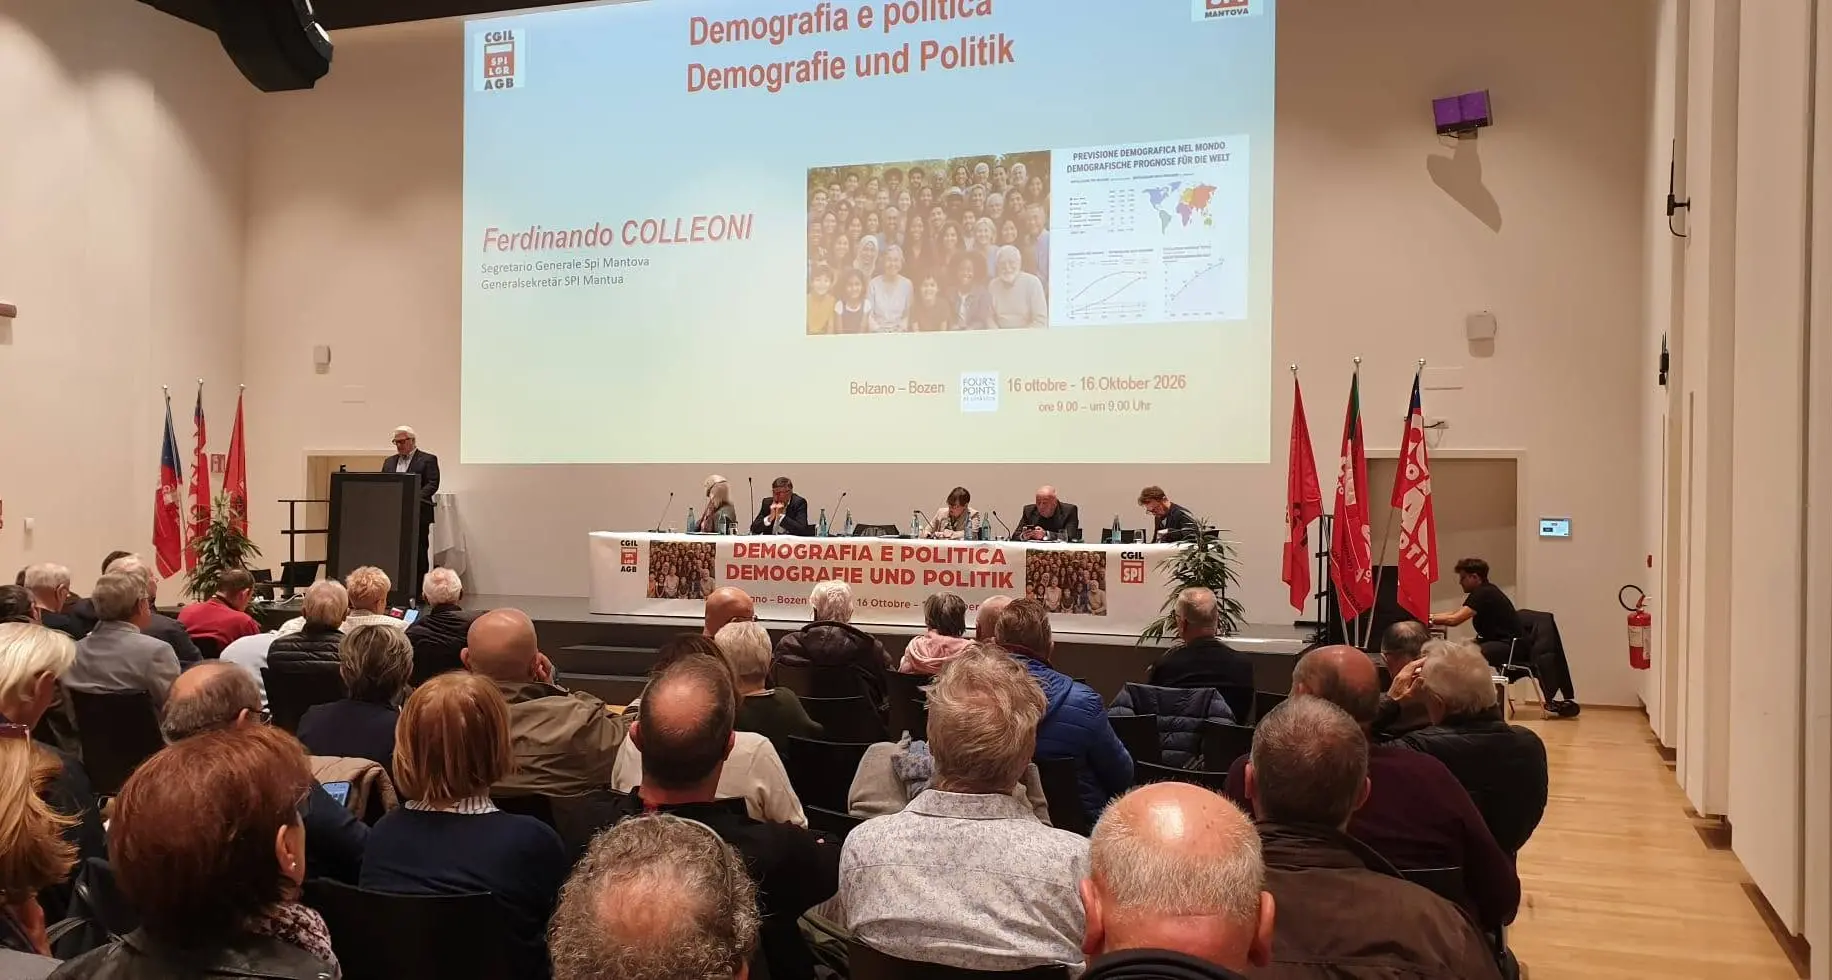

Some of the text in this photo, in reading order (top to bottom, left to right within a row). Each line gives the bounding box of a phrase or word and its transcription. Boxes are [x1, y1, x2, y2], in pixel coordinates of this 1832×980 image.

[1204, 8, 1249, 18] MANTOVA
[690, 2, 848, 45] Demografia
[857, 5, 873, 29] e
[484, 30, 515, 43] CGIL
[490, 57, 508, 66] SPI
[687, 33, 1015, 93] Demografie und Politik
[484, 78, 514, 90] AGB
[1072, 141, 1226, 160] PREVISIONE DEMOGRAFICA NEL MONDO
[1066, 153, 1231, 173] DEMOGRAFISCHE PROGNOSE FÜR DIE WELT
[482, 213, 754, 252] Ferdinando COLLEONI
[481, 256, 650, 275] Segretario Generale Spi Mantova
[481, 274, 624, 290] Generalsekretär SPI Mantua
[850, 381, 895, 395] Bolzano
[908, 380, 945, 394] Bozen
[1007, 378, 1022, 391] 16
[1025, 377, 1067, 392] ottobre
[1099, 375, 1149, 390] Oktober
[1153, 374, 1186, 389] 2026
[963, 386, 996, 396] POINTS
[1038, 404, 1055, 412] ore
[1057, 401, 1078, 412] 9.00
[1090, 403, 1106, 412] um
[1108, 400, 1130, 412] 9.00
[1132, 399, 1152, 411] Uhr
[733, 543, 1007, 565] DEMOGRAFIA E POLITICA
[1121, 551, 1144, 560] CGIL
[726, 564, 1014, 589] DEMOGRAFIE UND POLITIK
[1123, 567, 1142, 582] SPI
[777, 595, 807, 605] Bozen
[856, 598, 868, 607] 16
[870, 598, 911, 609] Ottobre
